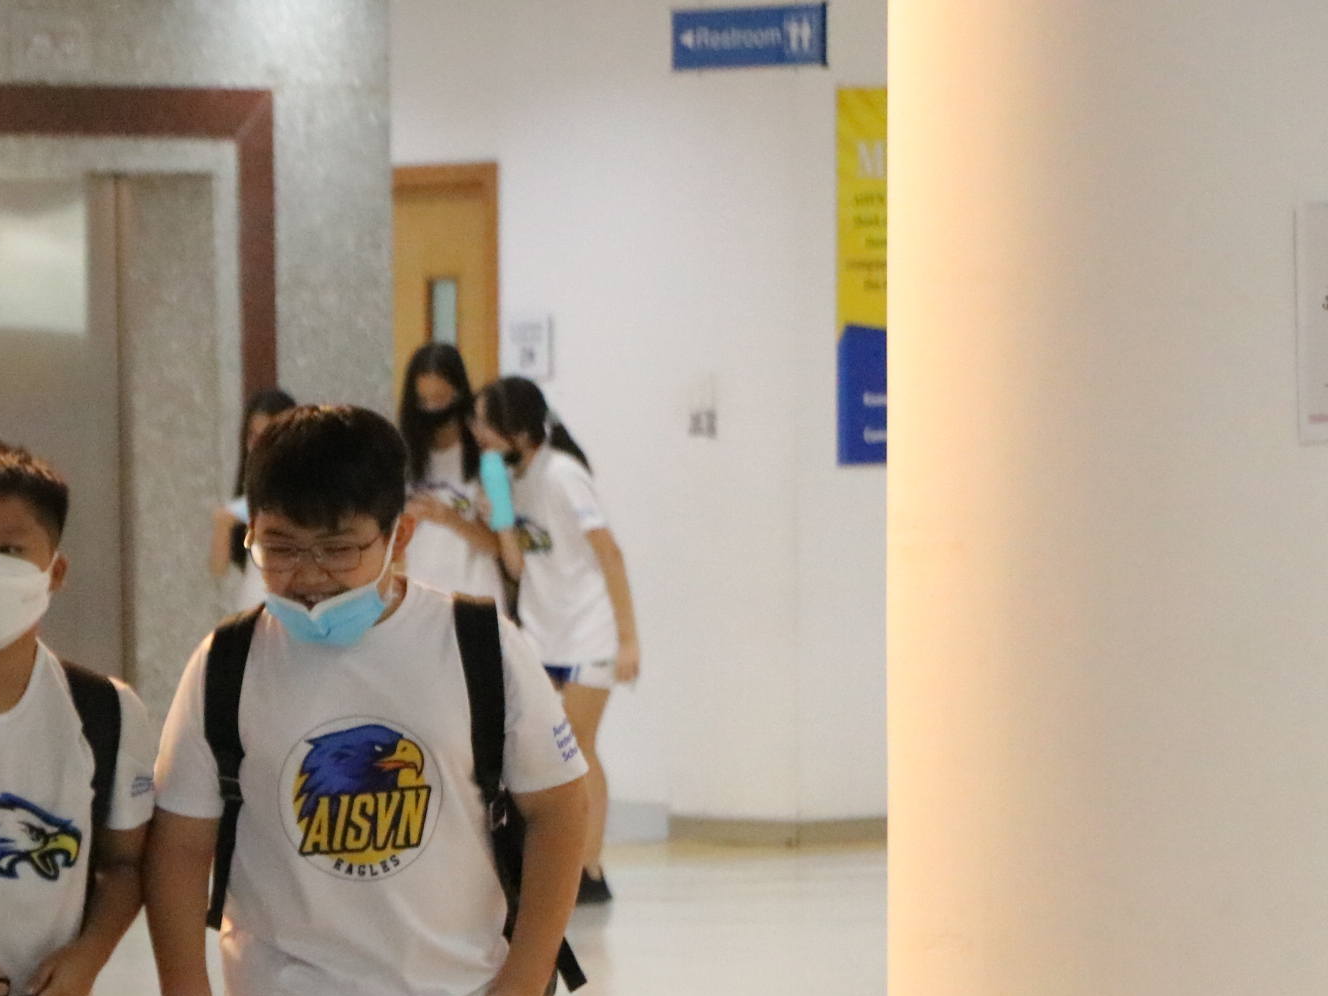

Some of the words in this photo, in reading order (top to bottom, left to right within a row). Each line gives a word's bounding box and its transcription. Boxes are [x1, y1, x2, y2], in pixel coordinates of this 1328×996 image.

[695, 26, 782, 50] Restroom
[299, 786, 431, 856] AISVN
[333, 854, 401, 877] EAGLES
